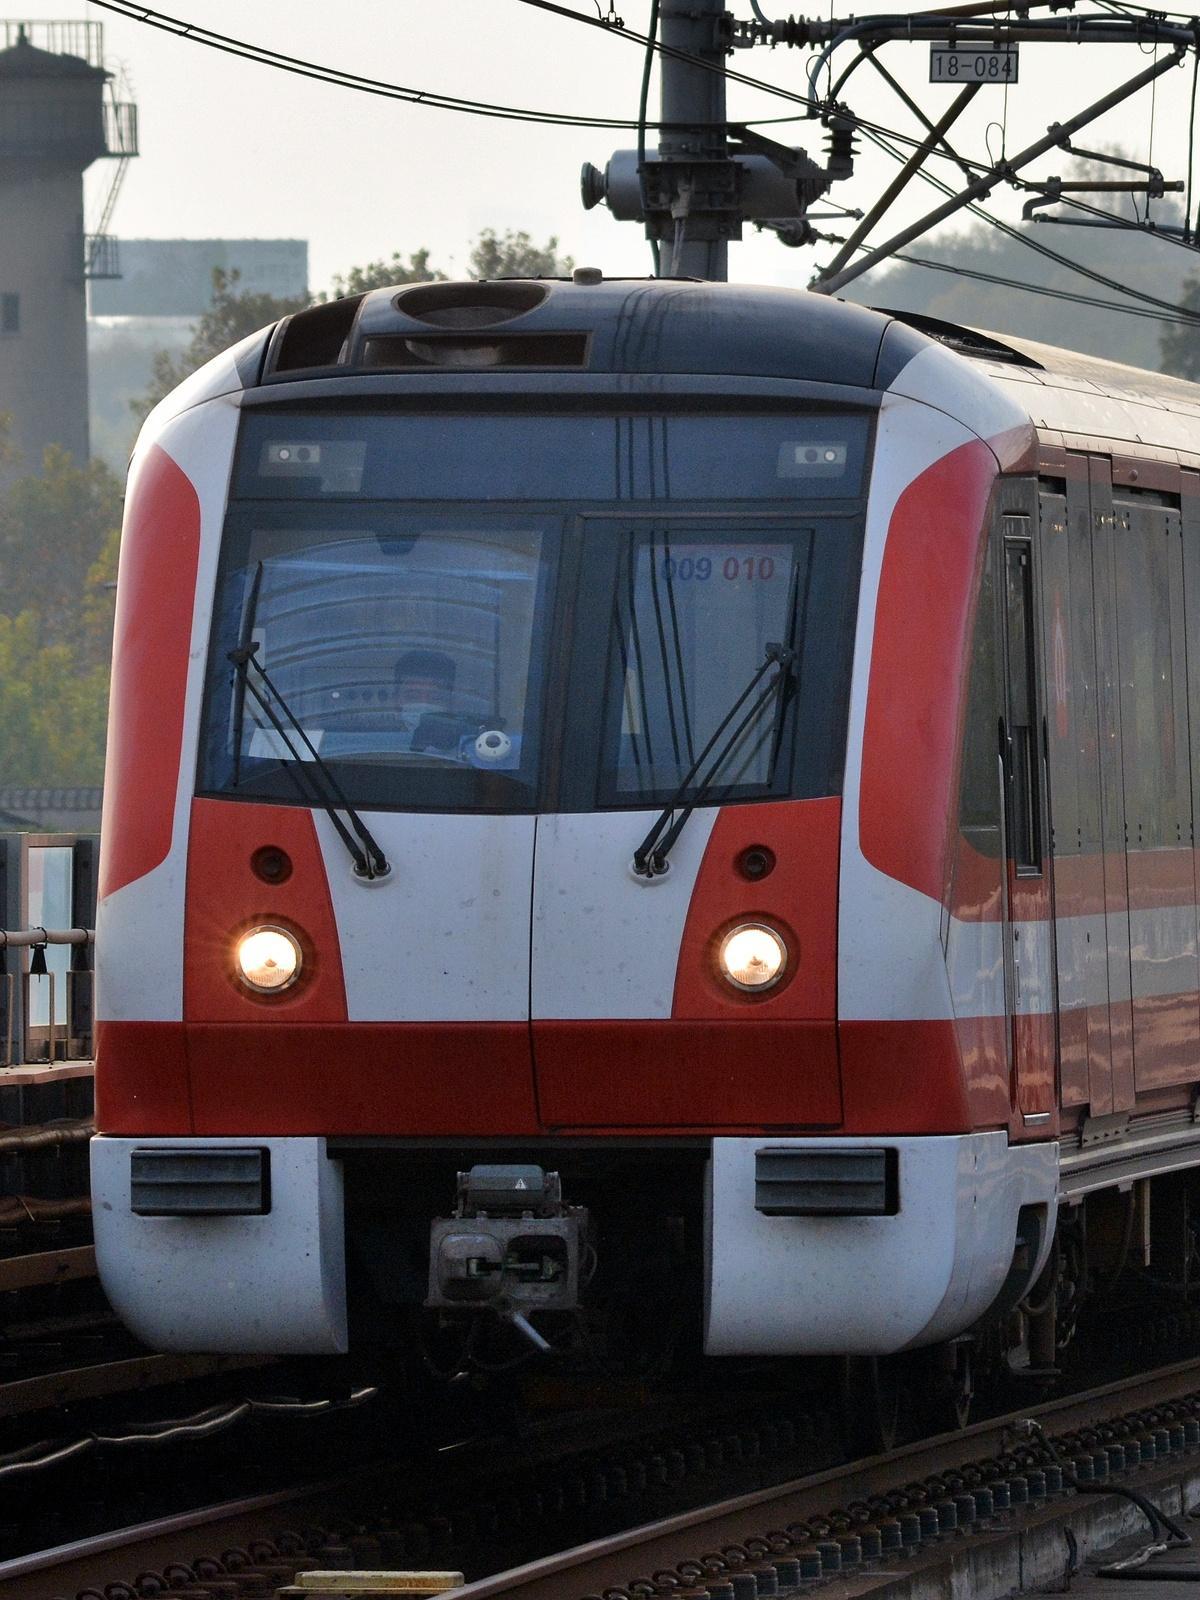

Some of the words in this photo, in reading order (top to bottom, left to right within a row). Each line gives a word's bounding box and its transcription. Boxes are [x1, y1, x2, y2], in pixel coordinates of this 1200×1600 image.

[936, 55, 1012, 77] 18-084
[661, 557, 712, 580] 009
[723, 557, 775, 580] 010
